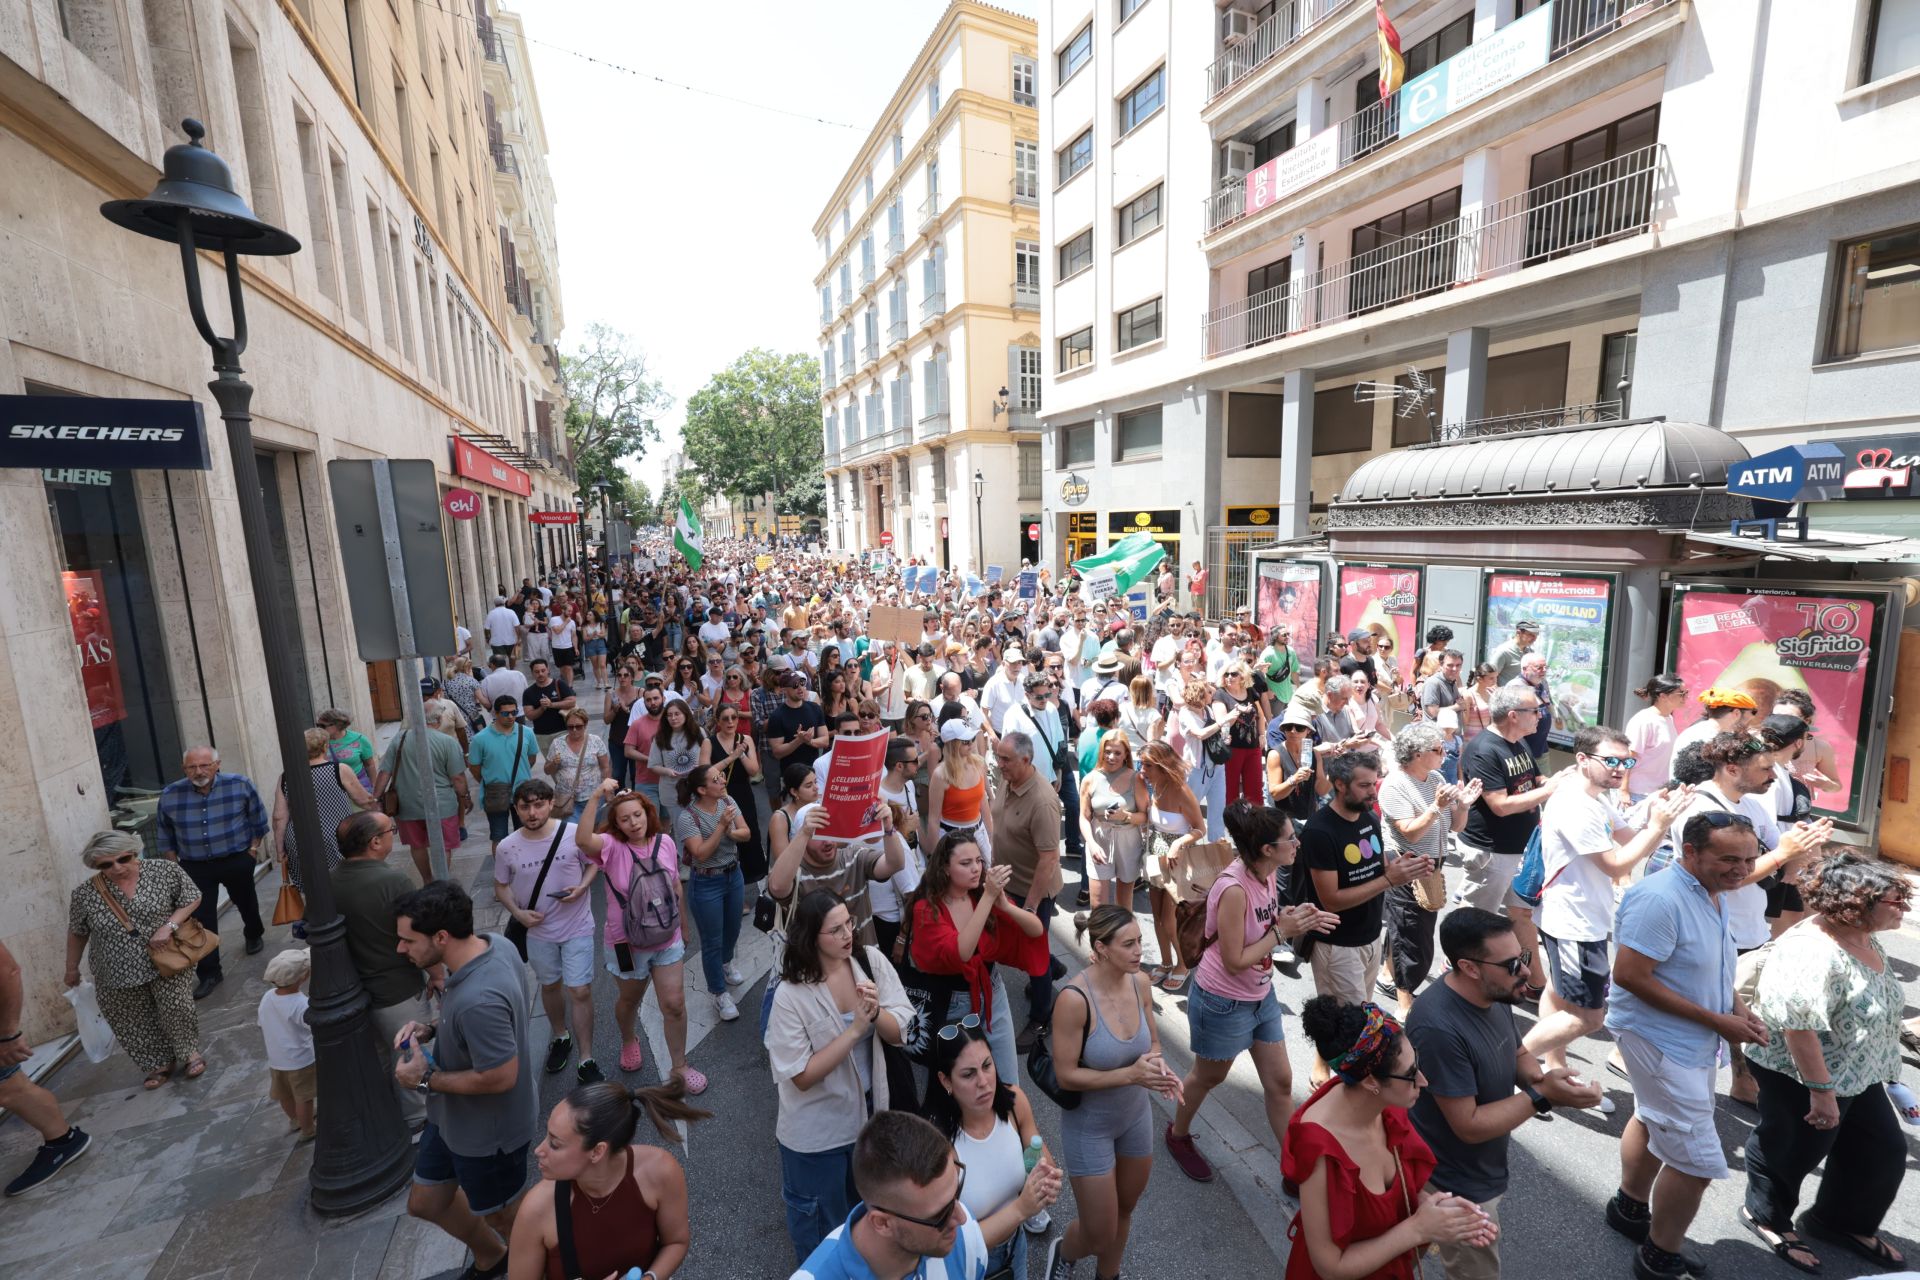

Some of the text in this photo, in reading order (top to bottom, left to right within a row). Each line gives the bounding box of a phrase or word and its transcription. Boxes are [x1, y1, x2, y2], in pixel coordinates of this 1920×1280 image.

[1282, 143, 1317, 166] Instituto
[1282, 151, 1318, 176] Nacional
[9, 424, 185, 442] SKECHERS
[1738, 466, 1793, 487] ATM
[1807, 463, 1841, 480] ATM
[449, 495, 474, 512] eh!
[1294, 567, 1315, 576] HERE
[1501, 580, 1541, 594] NEW
[1539, 587, 1596, 595] ATTRACTIONS
[1753, 588, 1797, 596] exteriorplus
[1383, 593, 1416, 608] Sigfrido
[1536, 604, 1598, 619] AQUALAND
[1716, 610, 1753, 622] READY
[1776, 634, 1864, 656] Sigfrido
[1785, 658, 1852, 671] ANIVERSARIO
